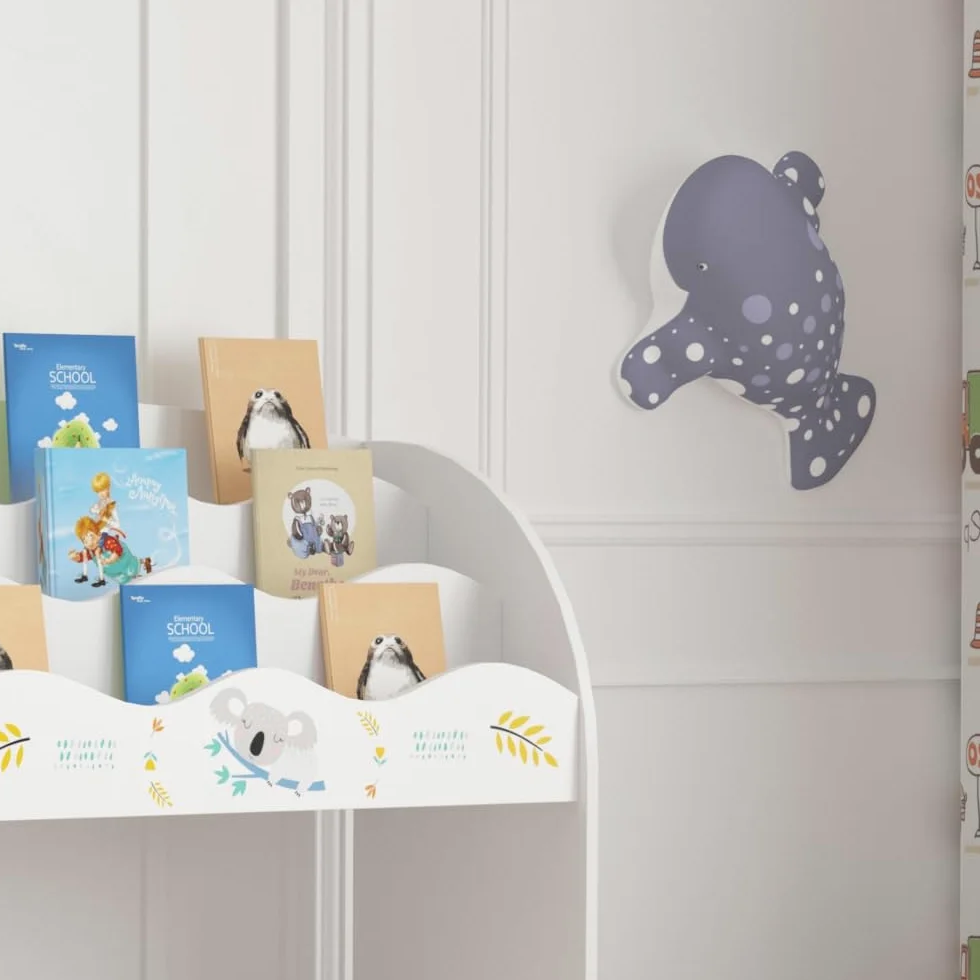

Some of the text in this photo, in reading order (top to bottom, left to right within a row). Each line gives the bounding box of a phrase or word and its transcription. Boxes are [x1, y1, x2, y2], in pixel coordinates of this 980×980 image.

[56, 363, 86, 372] Elementary
[49, 371, 96, 384] SCHOOL
[173, 614, 204, 622] Elementary
[166, 622, 214, 635] SCHOOL
